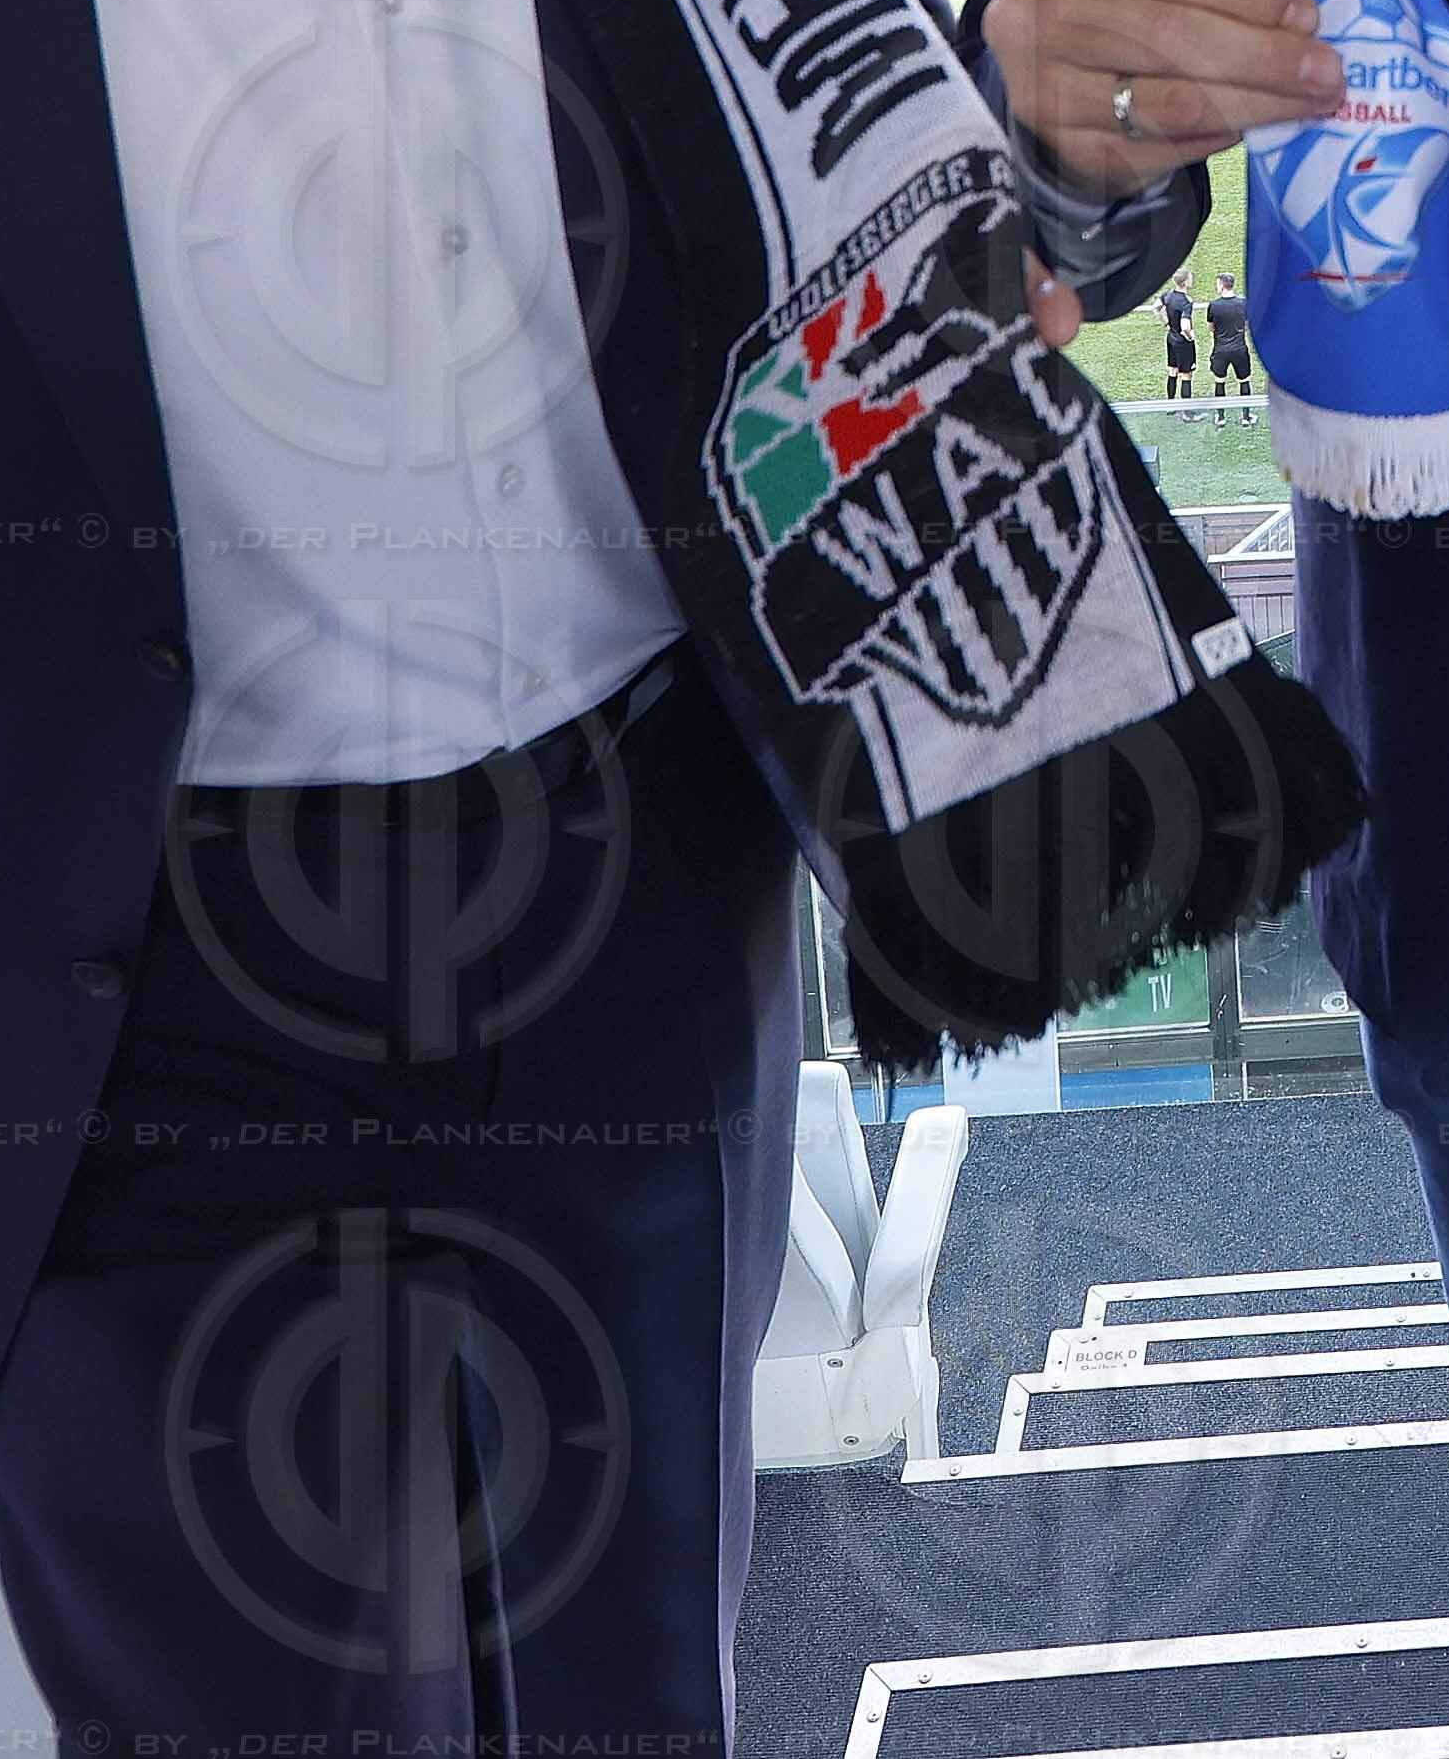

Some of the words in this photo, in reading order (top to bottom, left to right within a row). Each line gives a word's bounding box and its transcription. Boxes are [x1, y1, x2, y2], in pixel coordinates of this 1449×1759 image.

[767, 156, 973, 340] WOLFSBERGER
[812, 337, 1084, 602] WAC
[1148, 973, 1172, 1013] TV
[1076, 1351, 1124, 1362] BLOCK
[1128, 1349, 1137, 1359] D
